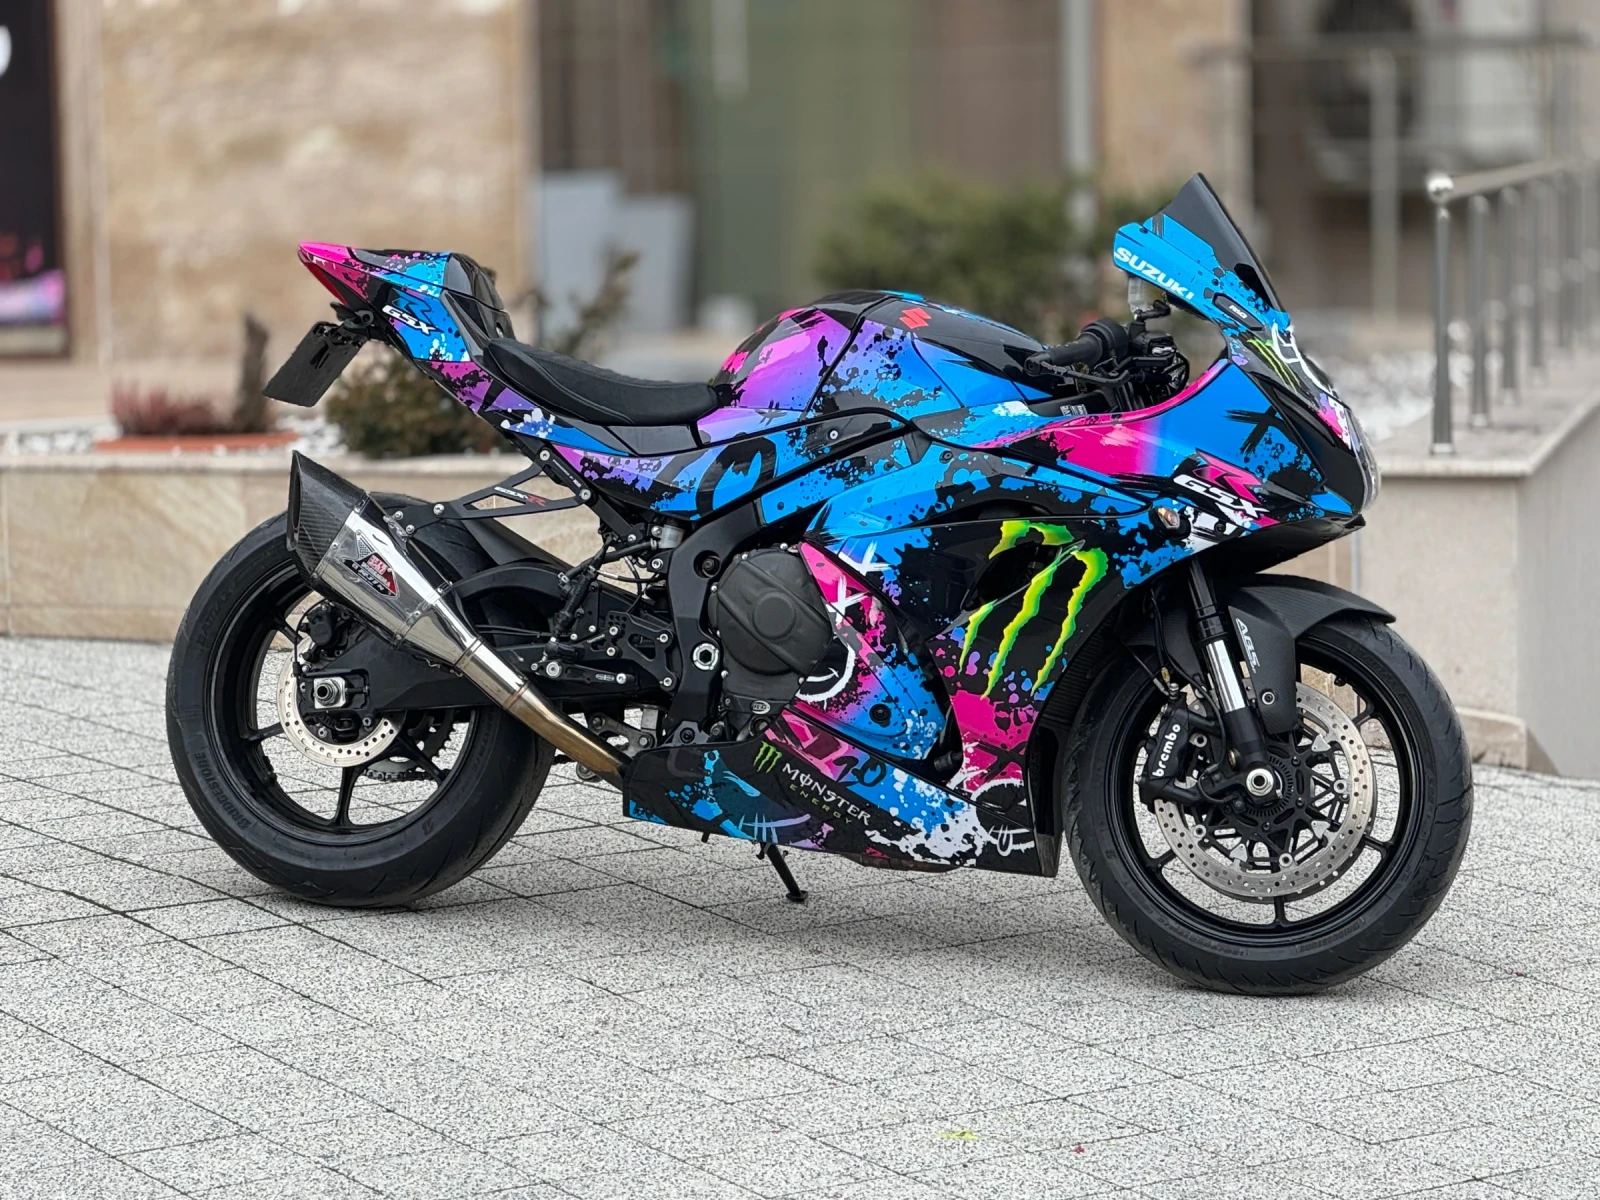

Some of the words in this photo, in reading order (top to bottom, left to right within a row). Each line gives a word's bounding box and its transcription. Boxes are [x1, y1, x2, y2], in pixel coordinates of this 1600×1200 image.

[1114, 247, 1194, 300] SUZUKI
[382, 304, 436, 335] GSX
[1173, 474, 1270, 518] GSX
[1235, 617, 1260, 668] ABS
[1152, 724, 1181, 777] brembo
[789, 783, 852, 824] ENERGY
